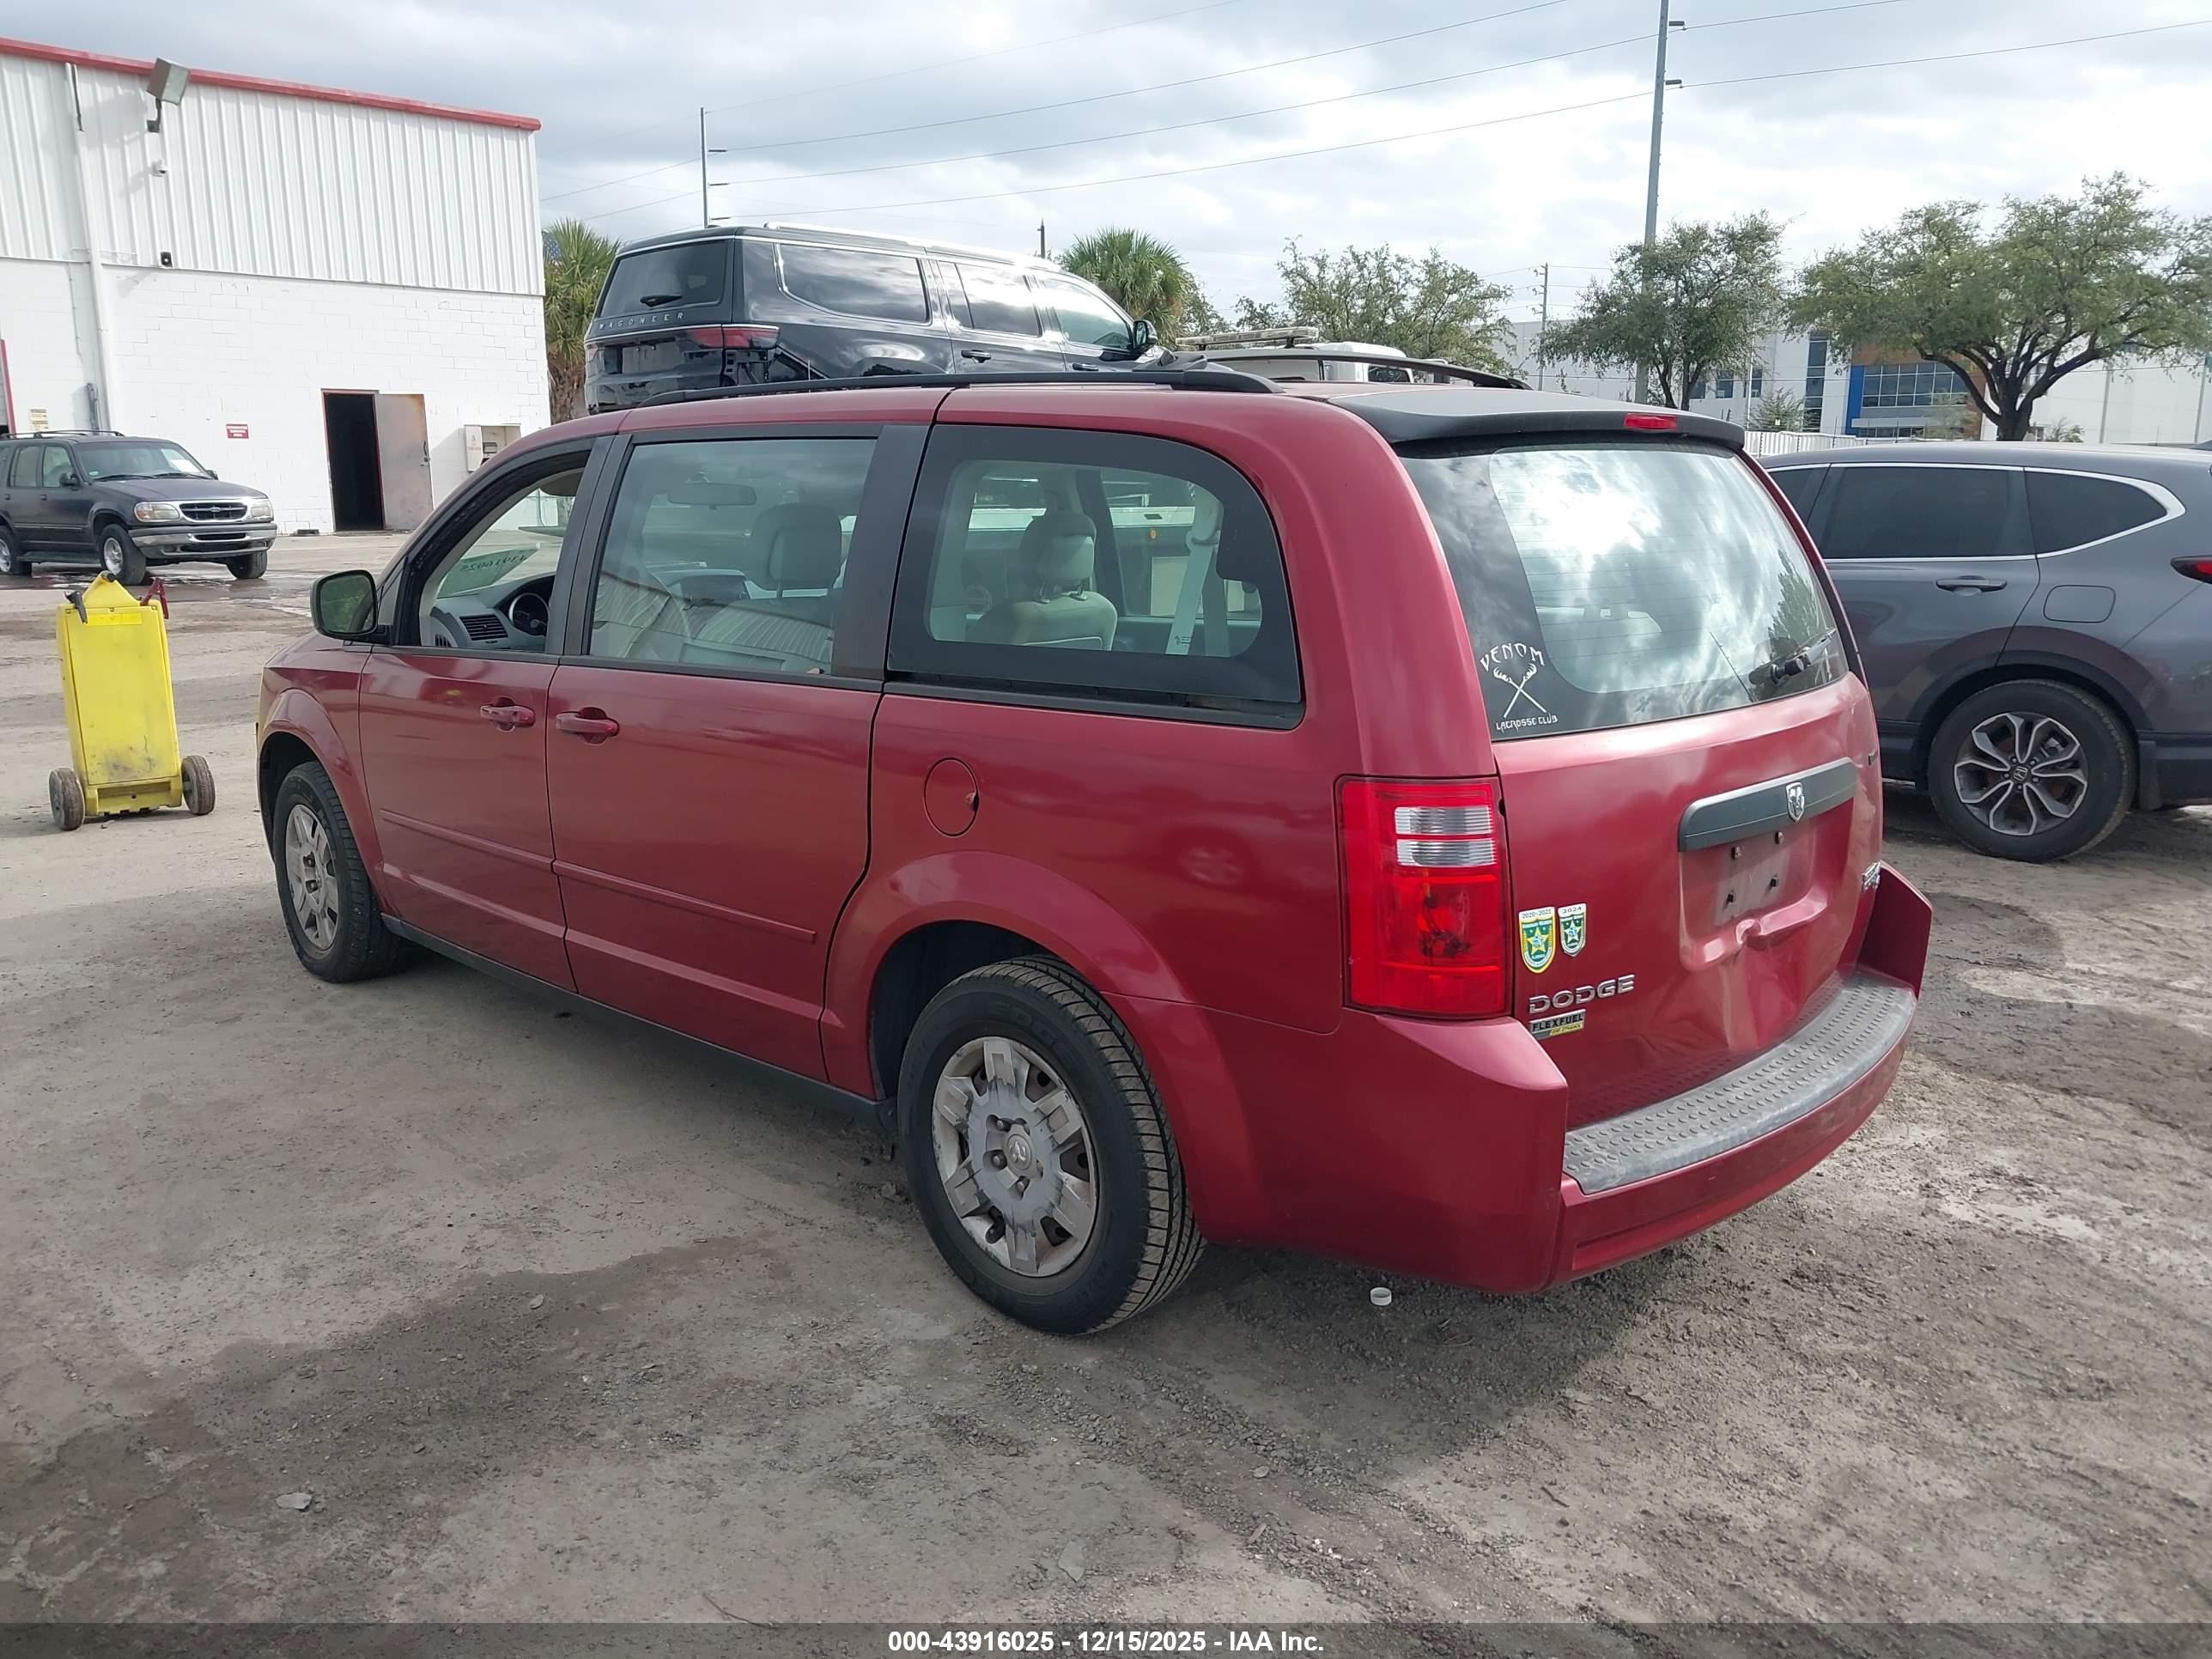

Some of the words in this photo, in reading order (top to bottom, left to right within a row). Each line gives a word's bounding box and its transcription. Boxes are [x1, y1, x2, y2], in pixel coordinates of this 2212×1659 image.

[599, 312, 684, 330] WAGONEER
[1480, 642, 1545, 672] VENOM
[1496, 718, 1537, 733] LACROSSE
[1538, 713, 1559, 724] CLUB
[1562, 906, 1582, 915] 2024
[1528, 974, 1636, 1014] DODGE
